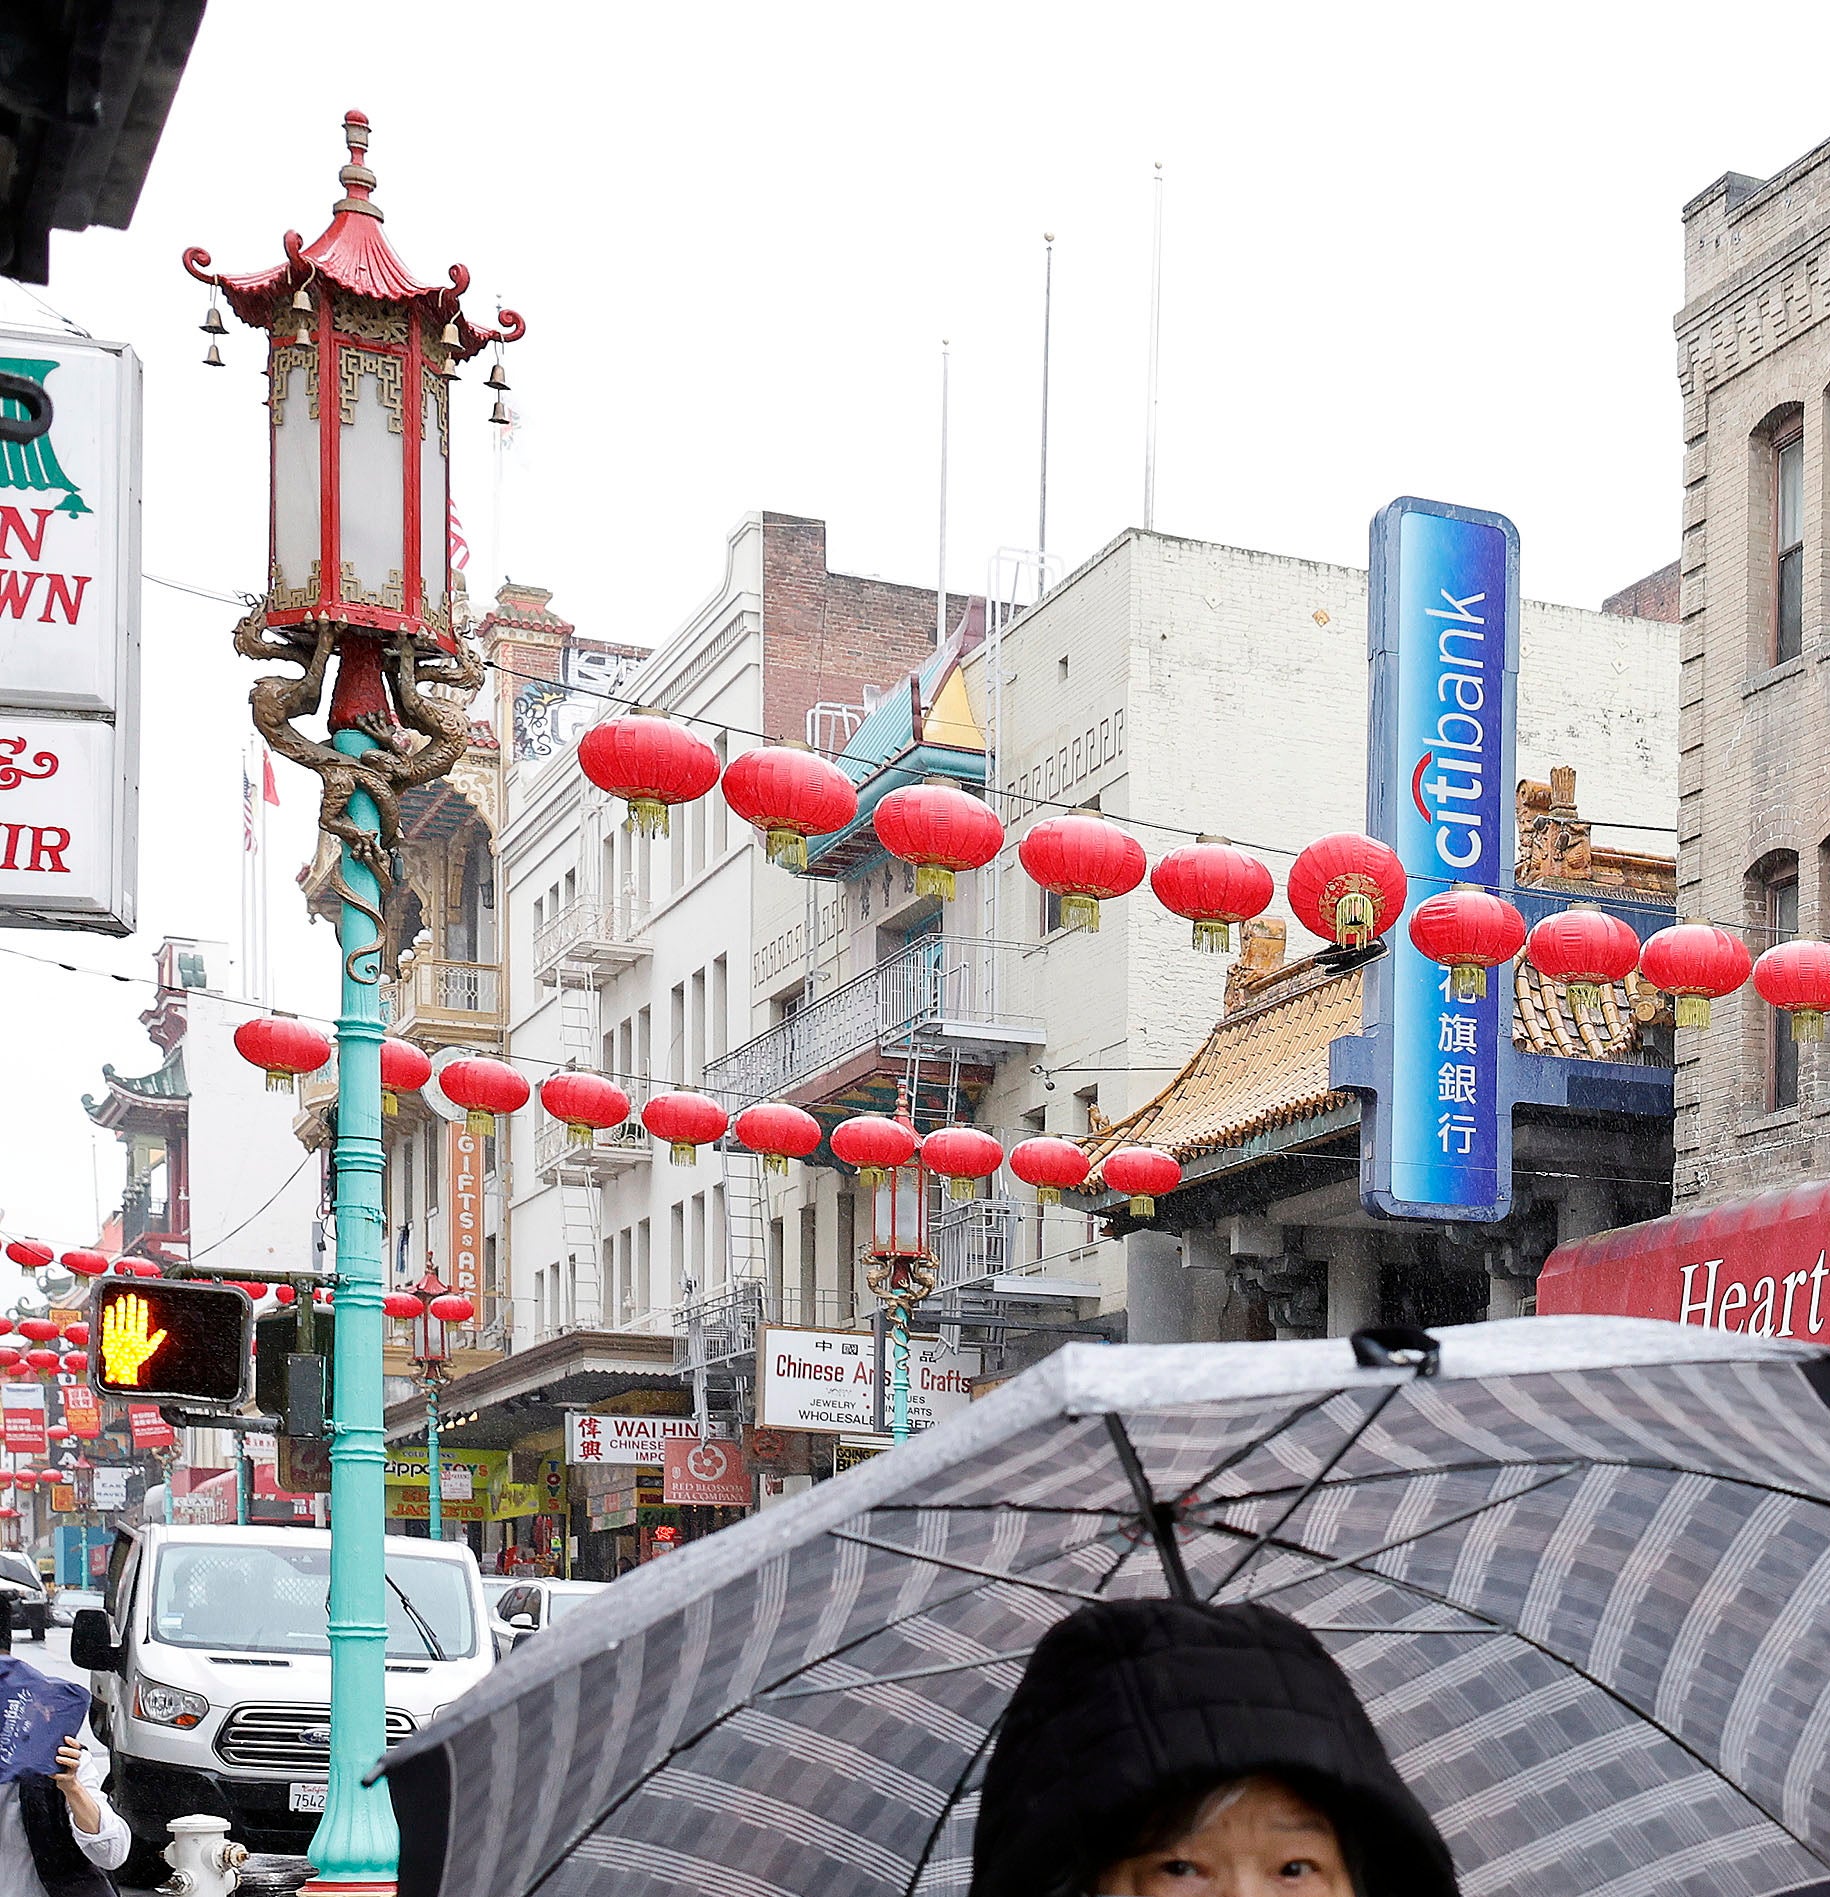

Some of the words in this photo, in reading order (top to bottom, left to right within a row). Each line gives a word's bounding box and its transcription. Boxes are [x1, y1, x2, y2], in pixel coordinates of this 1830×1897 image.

[1411, 587, 1486, 868] citibank
[457, 1135, 475, 1229] GIFTS
[1677, 1250, 1830, 1338] Heart
[776, 1354, 844, 1382] Chinese
[920, 1367, 972, 1394] Crafts
[810, 1398, 856, 1409] JEWELRY
[907, 1407, 933, 1417] ARTS
[799, 1409, 875, 1426] WHOLESALE
[614, 1420, 656, 1438] WAI
[610, 1439, 664, 1451] CHINESE
[837, 1448, 869, 1460] GOING
[546, 1460, 561, 1511] TOYS
[672, 1482, 693, 1491] RED
[695, 1483, 744, 1493] BLOSSOM
[672, 1492, 691, 1500] TEA
[692, 1492, 744, 1502] COMPANY
